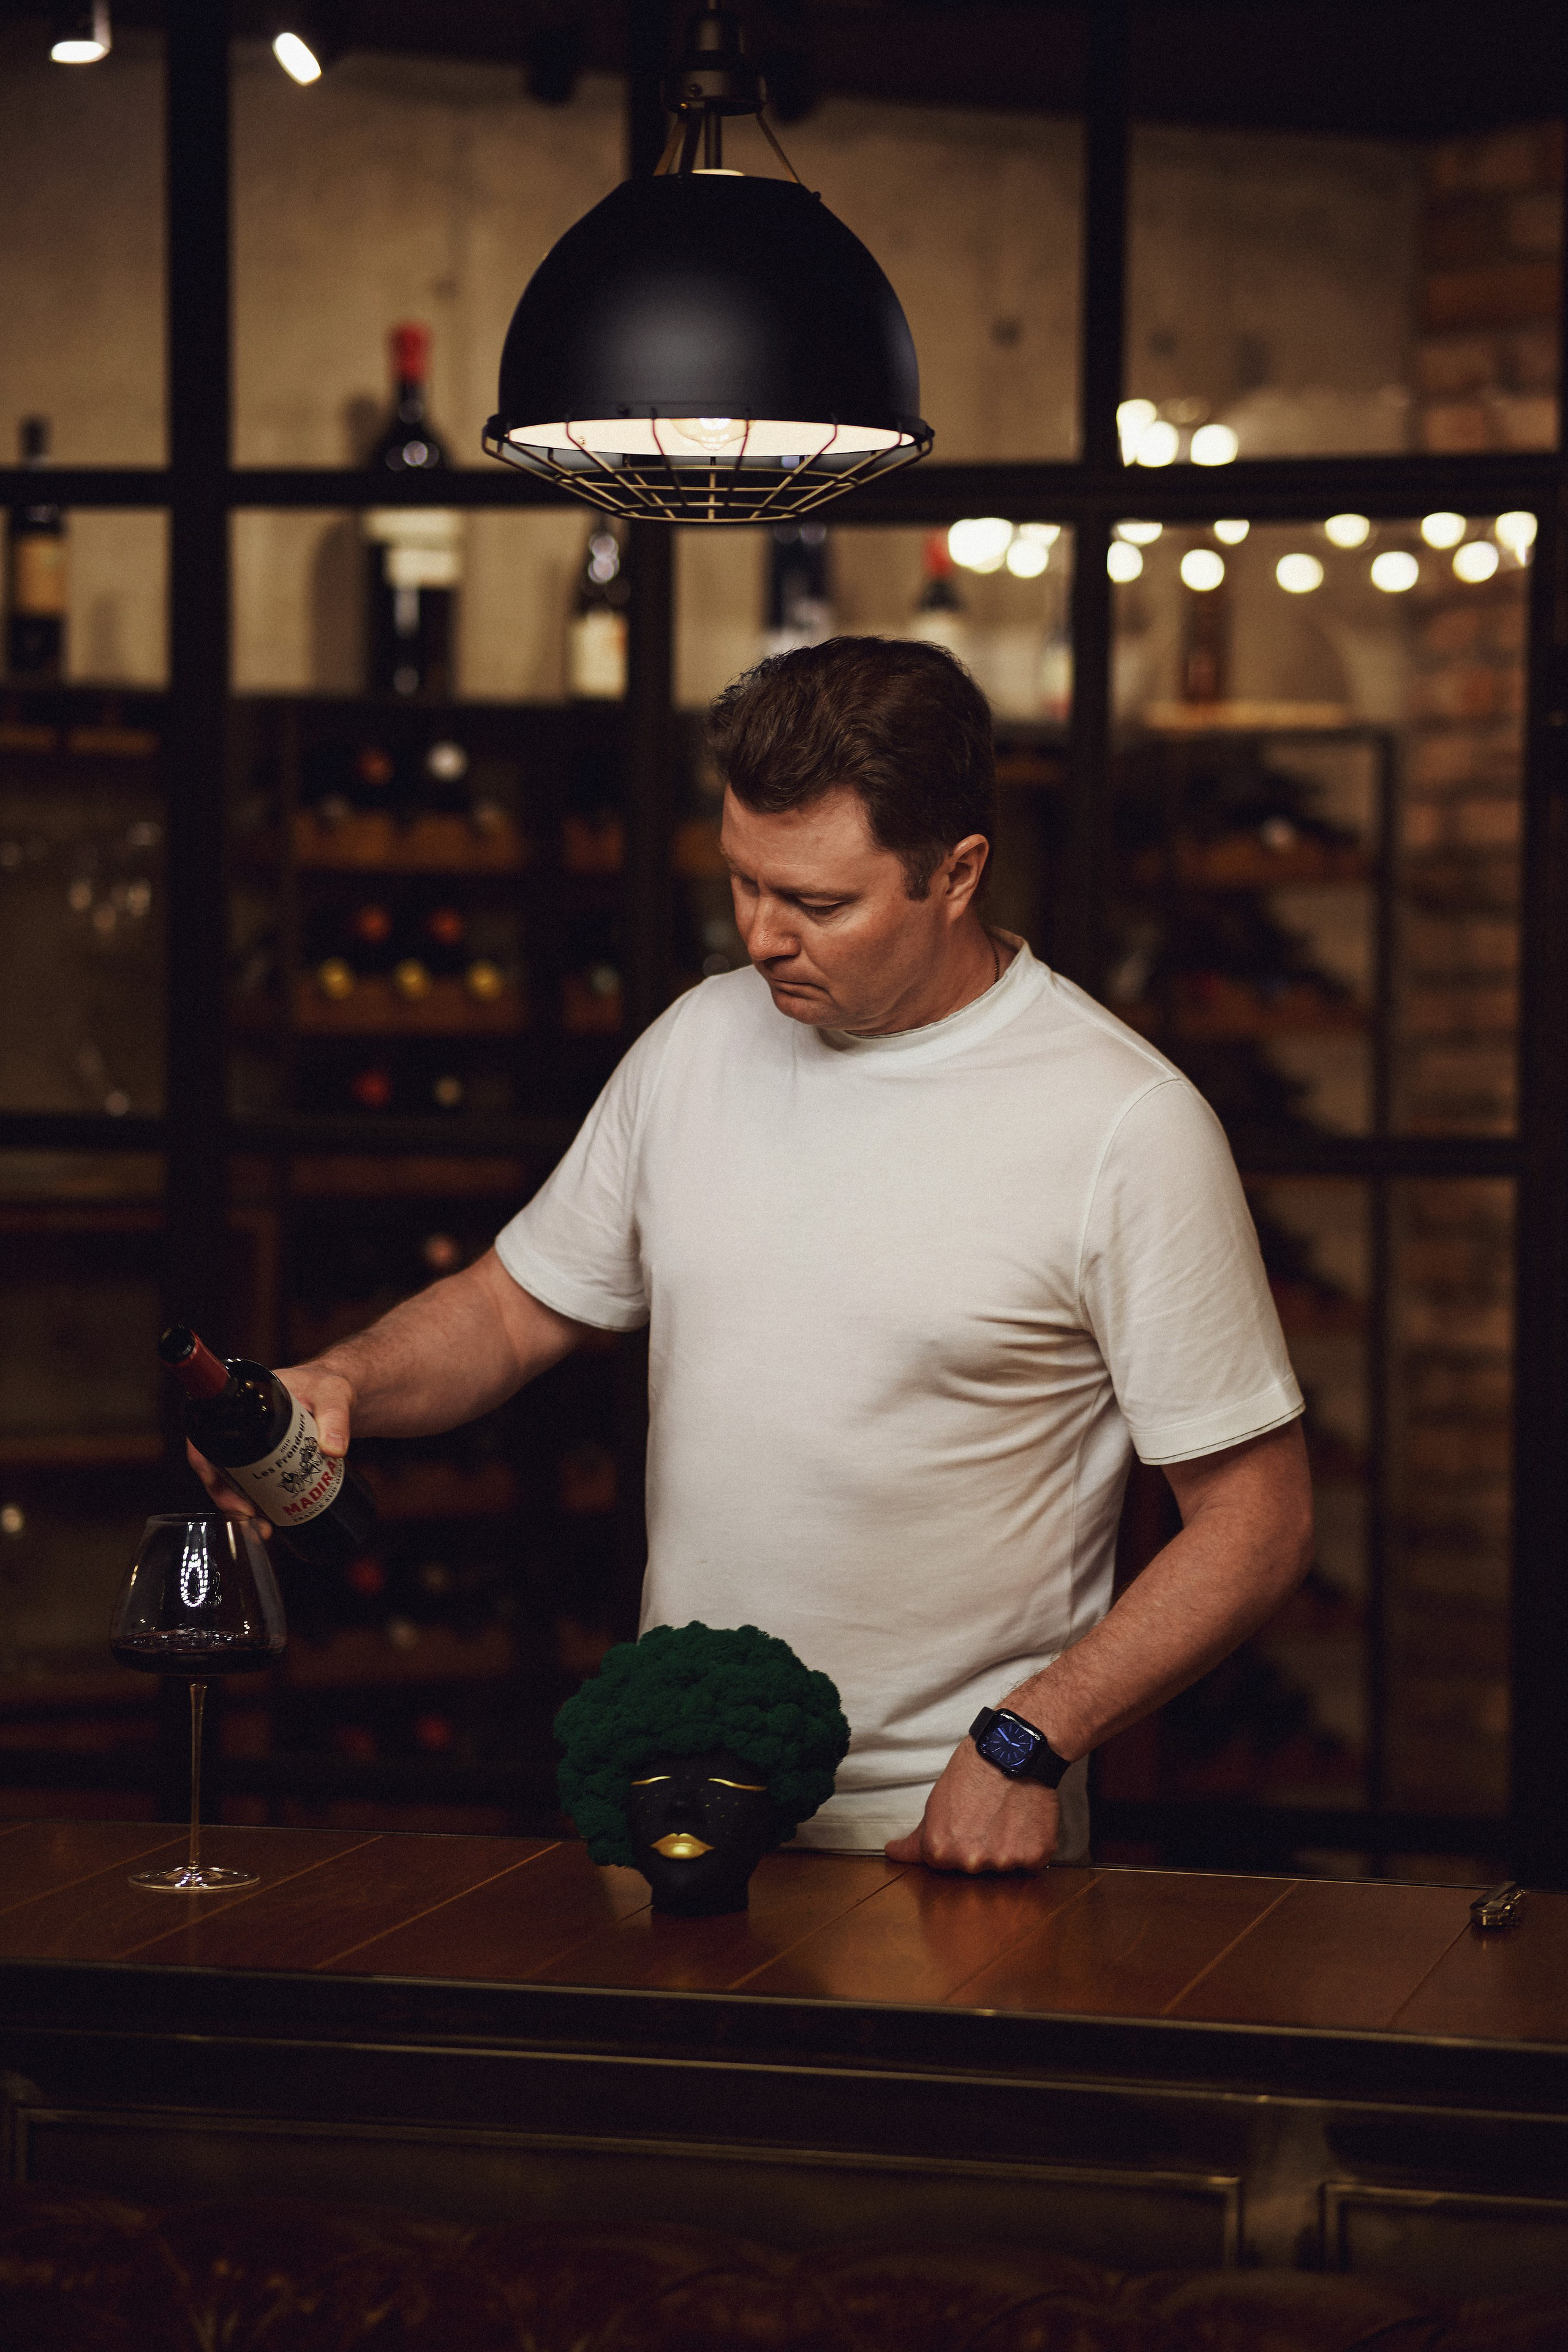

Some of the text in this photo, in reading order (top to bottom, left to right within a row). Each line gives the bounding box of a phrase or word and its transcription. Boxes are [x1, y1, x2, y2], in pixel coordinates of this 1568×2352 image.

[252, 1412, 306, 1480] Les Frondeurs
[282, 1458, 339, 1516] MADIRA
